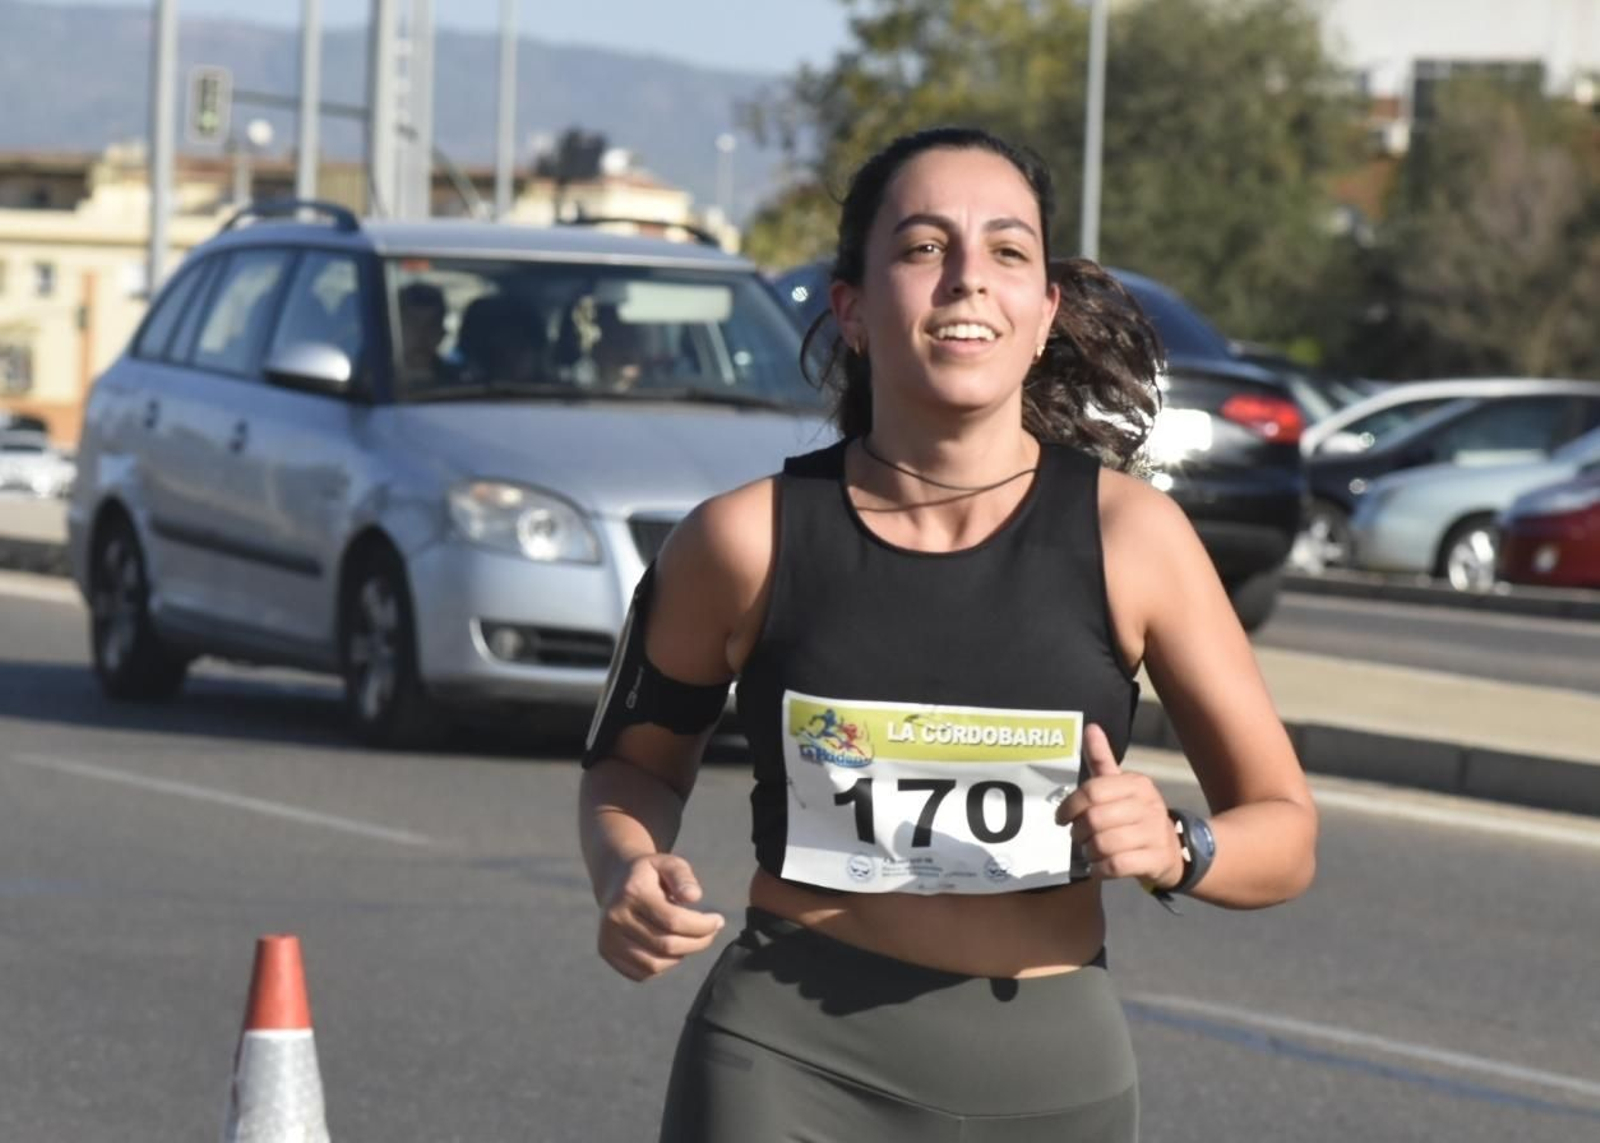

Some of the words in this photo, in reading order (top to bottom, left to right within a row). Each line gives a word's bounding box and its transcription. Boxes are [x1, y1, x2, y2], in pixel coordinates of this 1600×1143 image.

[888, 722, 915, 742] LA
[921, 724, 1065, 746] CORDOBARIA
[834, 778, 1023, 847] 170
